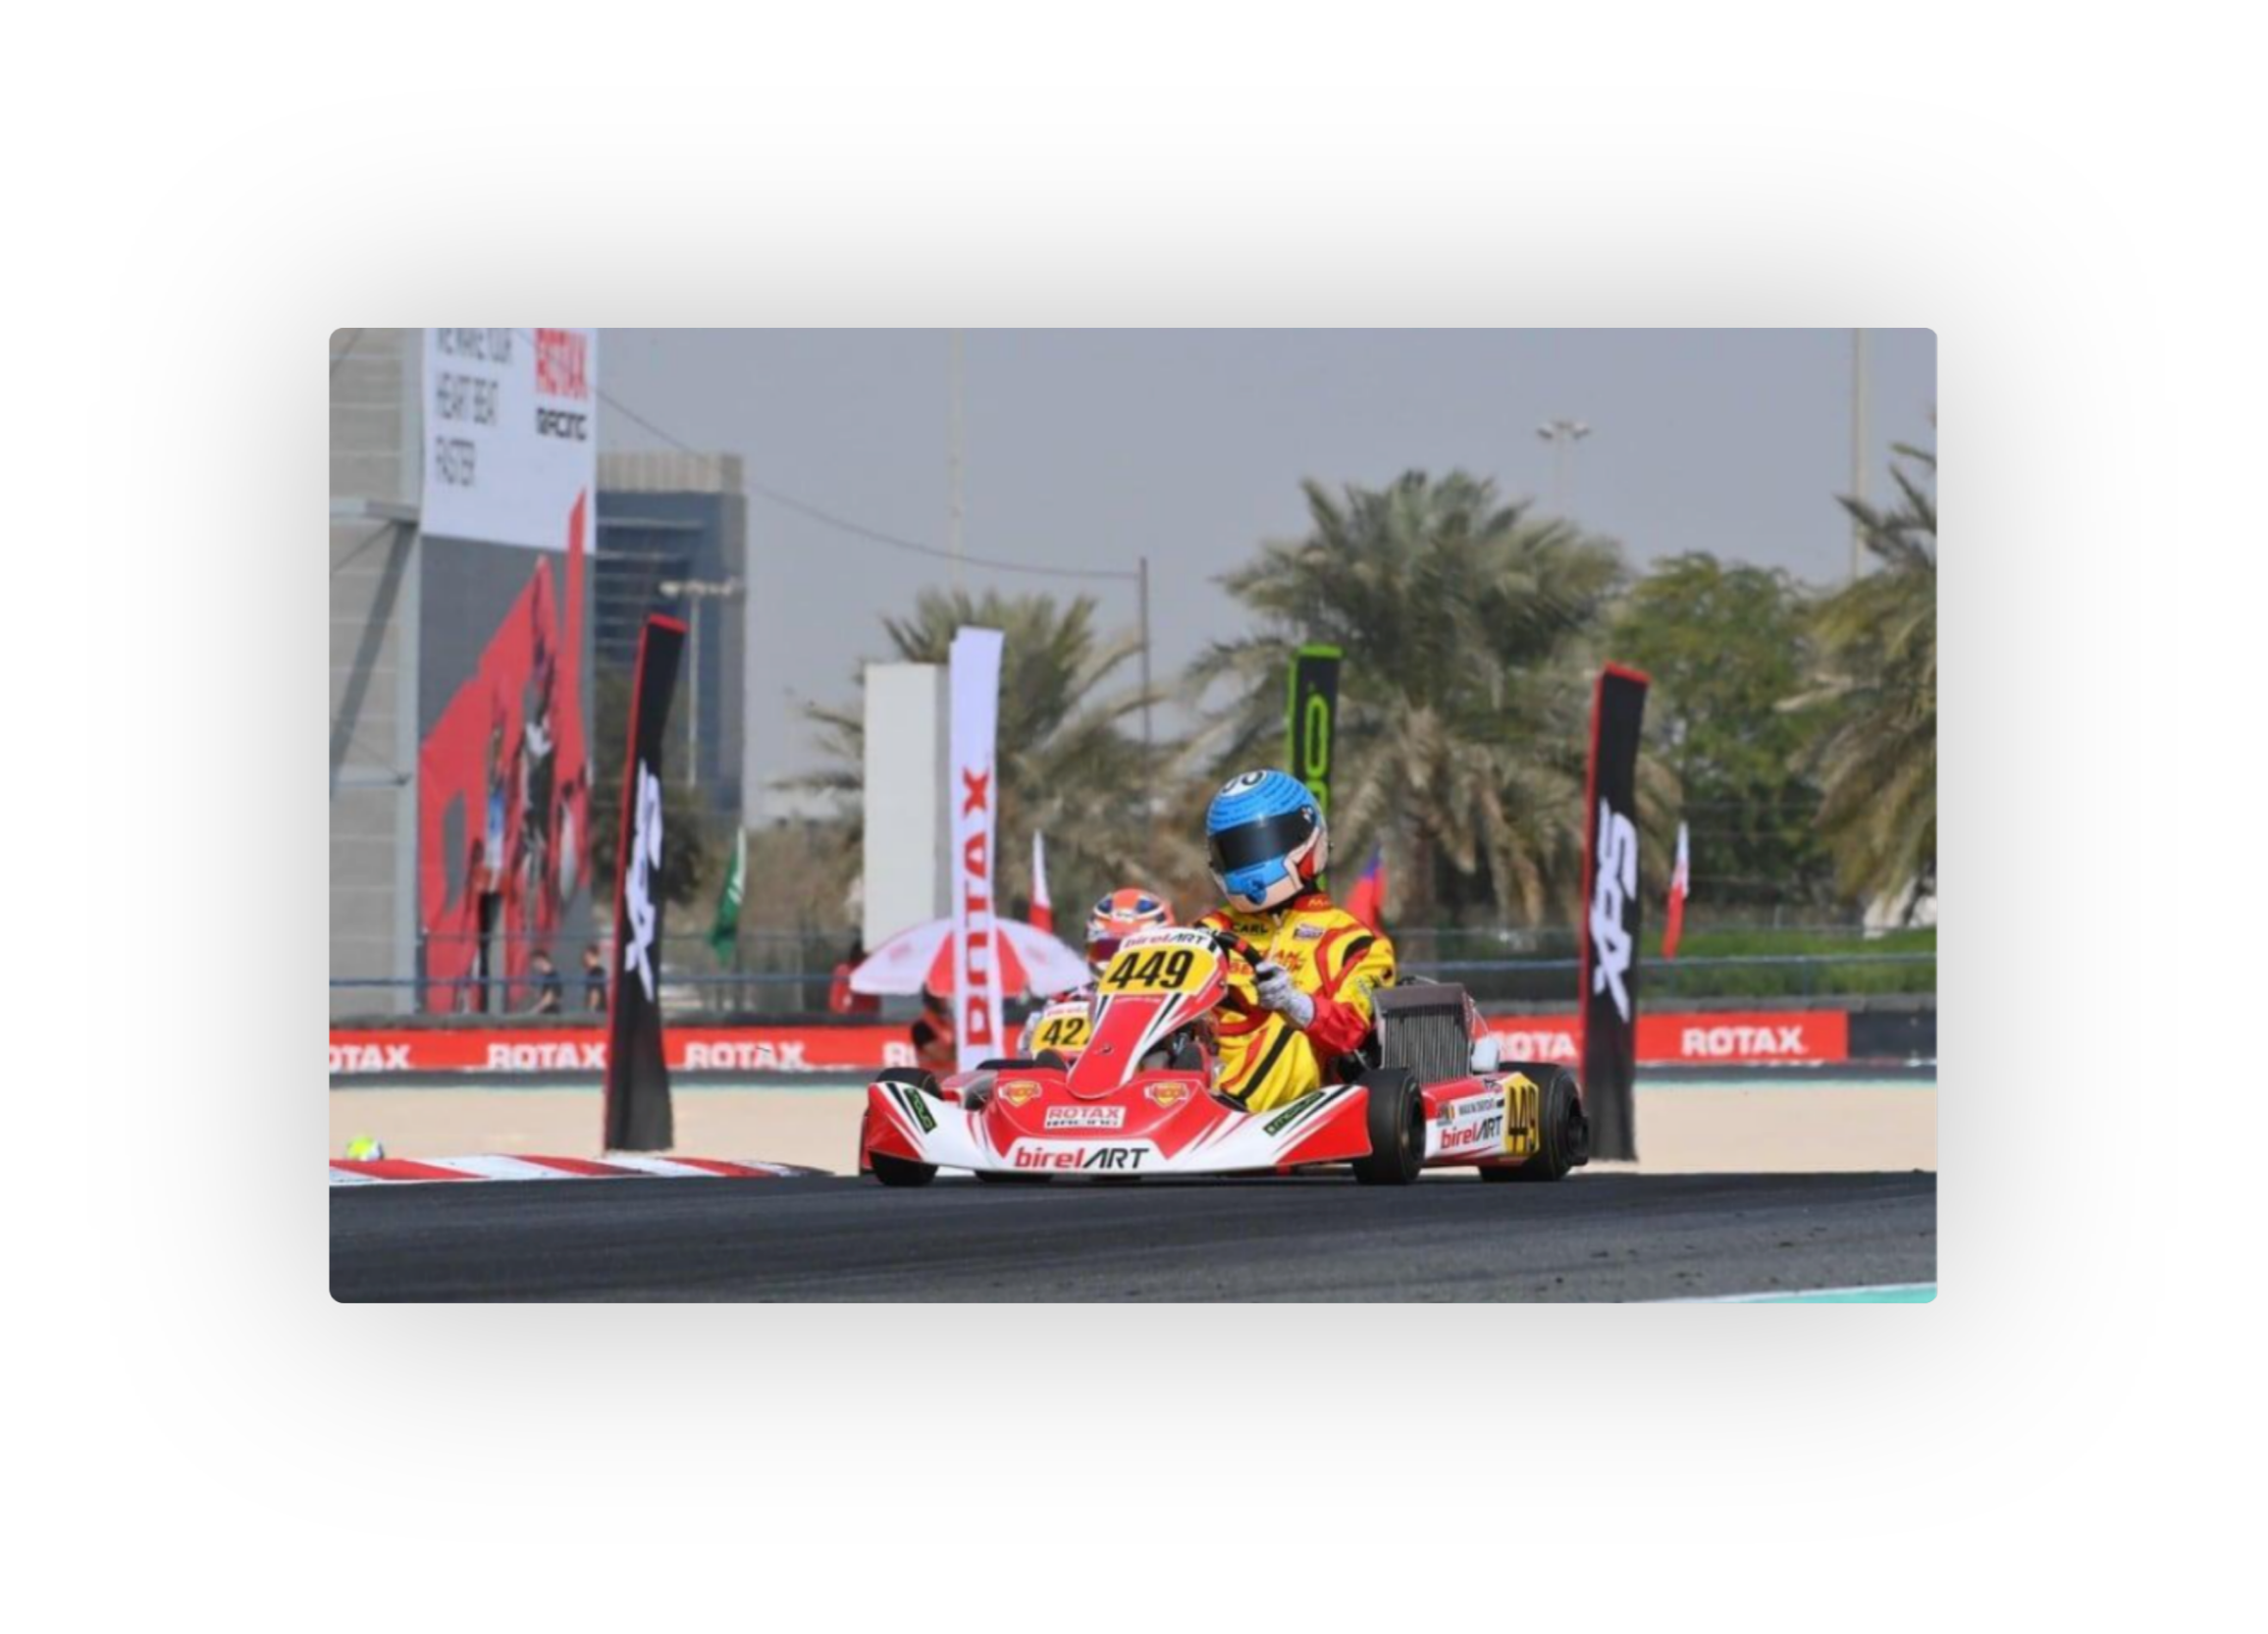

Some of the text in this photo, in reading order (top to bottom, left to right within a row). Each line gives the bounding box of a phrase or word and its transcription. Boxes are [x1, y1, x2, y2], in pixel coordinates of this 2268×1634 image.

[1107, 949, 1194, 989] 449
[1040, 1017, 1090, 1046] 42
[1681, 1027, 1806, 1056] ROTAX
[329, 1043, 410, 1071] OTAX
[487, 1042, 607, 1070] ROTAX
[684, 1040, 805, 1070] ROTAX
[1495, 1030, 1577, 1064] ROTA
[1047, 1107, 1119, 1120] ROTAX
[1508, 1085, 1537, 1151] 449
[1440, 1116, 1503, 1149] birelART
[1014, 1146, 1149, 1169] birelART
